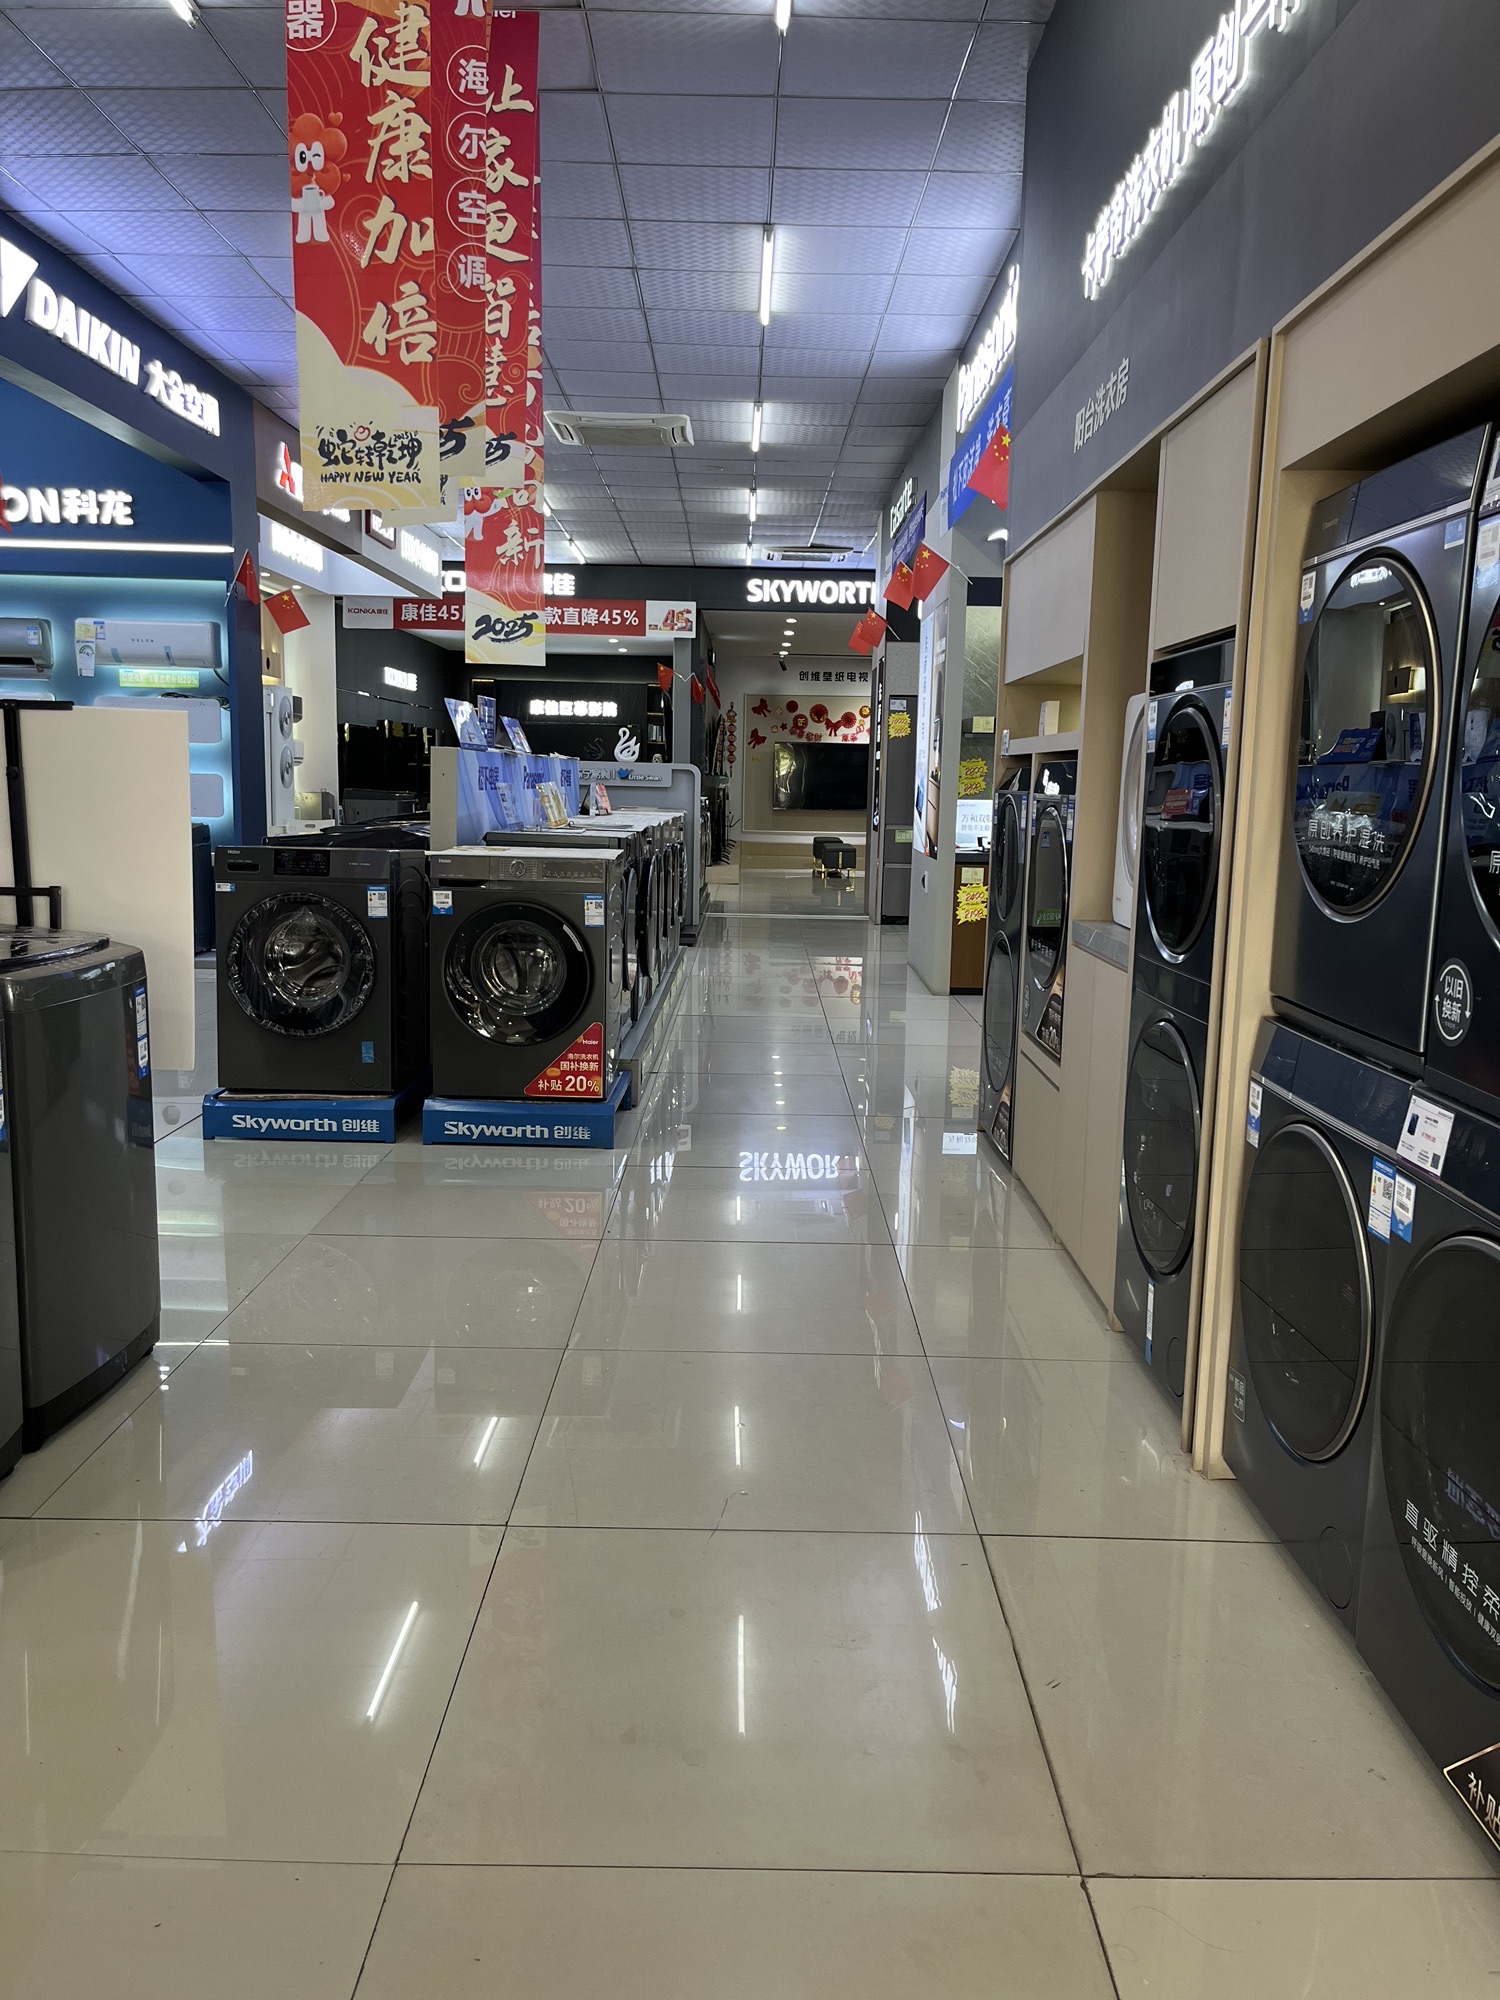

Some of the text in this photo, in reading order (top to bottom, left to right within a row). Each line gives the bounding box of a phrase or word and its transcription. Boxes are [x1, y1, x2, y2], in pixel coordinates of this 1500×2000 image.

[350, 2, 438, 366] 健康加倍
[458, 58, 488, 291] 海尔空调
[24, 275, 141, 386] DAIKIN
[320, 470, 422, 484] HAPPY NEW YEAR
[347, 607, 377, 615] KONKA
[401, 603, 466, 623] 康佳45
[472, 612, 539, 645] 2025
[798, 671, 869, 682] 创维壁纸电视
[1444, 975, 1464, 1000] 以旧
[1441, 998, 1462, 1022] 换新
[560, 1061, 599, 1072] 国补换新
[567, 1053, 599, 1061] 海尔洗衣机
[538, 1075, 600, 1092] 补贴 20%
[232, 1113, 380, 1134] Skyworth 创维
[444, 1121, 592, 1141] Skyworth 创维
[1404, 1499, 1500, 1622] 直驱精控柔
